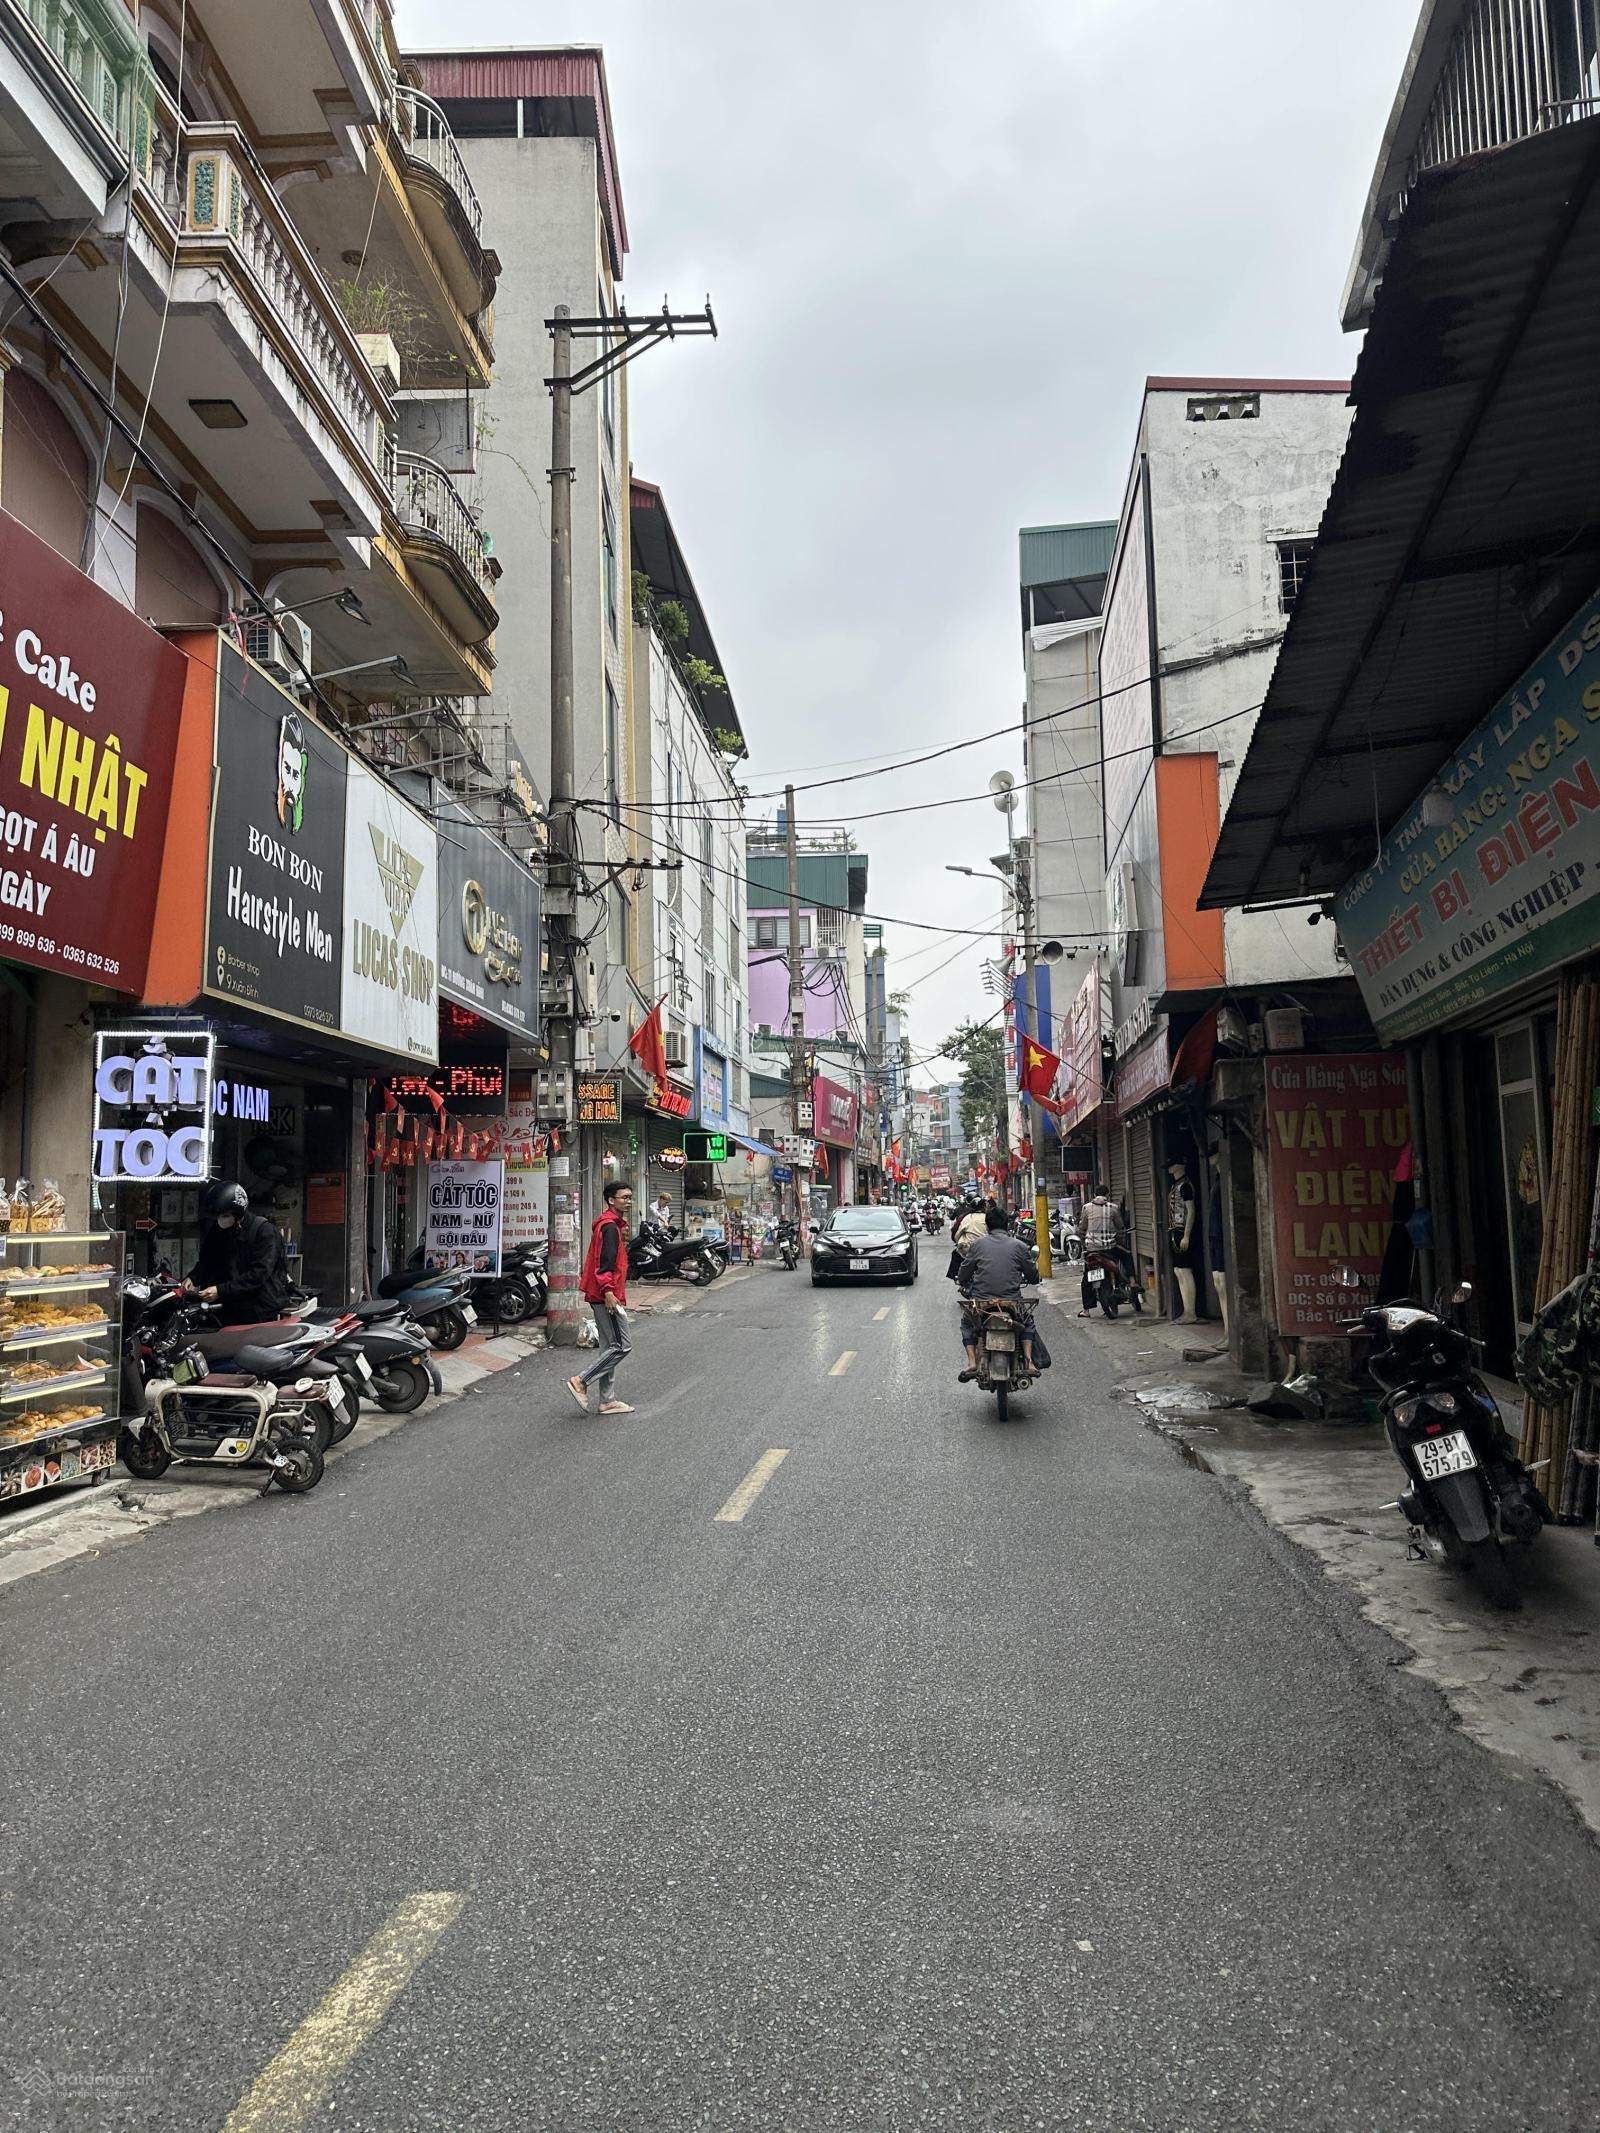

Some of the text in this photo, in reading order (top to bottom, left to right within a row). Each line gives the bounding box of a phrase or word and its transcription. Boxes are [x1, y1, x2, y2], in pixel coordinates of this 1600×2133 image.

[15, 629, 97, 713] Cake
[1442, 744, 1487, 797] XÂY
[1493, 677, 1547, 746] LẮP
[1506, 716, 1580, 793] NGA
[20, 703, 148, 843] NHẬT
[40, 823, 58, 864] Á
[62, 833, 96, 877] ÂU
[248, 824, 324, 895] BON BON
[1356, 757, 1600, 978] THIẾT BỊ ĐIỆN
[0, 867, 51, 917] GÀY
[226, 866, 333, 963] Hairstyle Men
[1439, 952, 1451, 972] &
[1451, 918, 1497, 961] CÔNG
[1497, 861, 1585, 934] NGHIỆP
[16, 929, 35, 948] 899
[37, 936, 55, 954] 636
[63, 944, 85, 964] 0363
[86, 952, 102, 969] 632
[103, 957, 120, 975] 526
[353, 918, 398, 991] LUCAS
[402, 945, 434, 1006] SHOP
[1271, 1062, 1301, 1089] Cửa
[1305, 1061, 1346, 1094] Hàng
[1348, 1062, 1377, 1093] Nga
[233, 1083, 269, 1122] NAM
[595, 1101, 618, 1120] HOA
[1274, 1101, 1347, 1158] VẬT
[430, 1176, 499, 1208] CẮT TÓC
[1294, 1161, 1396, 1213] ĐIỆN
[430, 1213, 462, 1228] NAM
[472, 1211, 496, 1228] NỮ
[437, 1231, 460, 1248] GỘI
[1293, 1221, 1391, 1265] LẠN
[1293, 1273, 1316, 1287] ĐT:
[1315, 1290, 1335, 1305] Số
[1296, 1307, 1322, 1322] Bắc
[1421, 1435, 1459, 1459] 29-B1
[1422, 1451, 1473, 1477] 575.79
